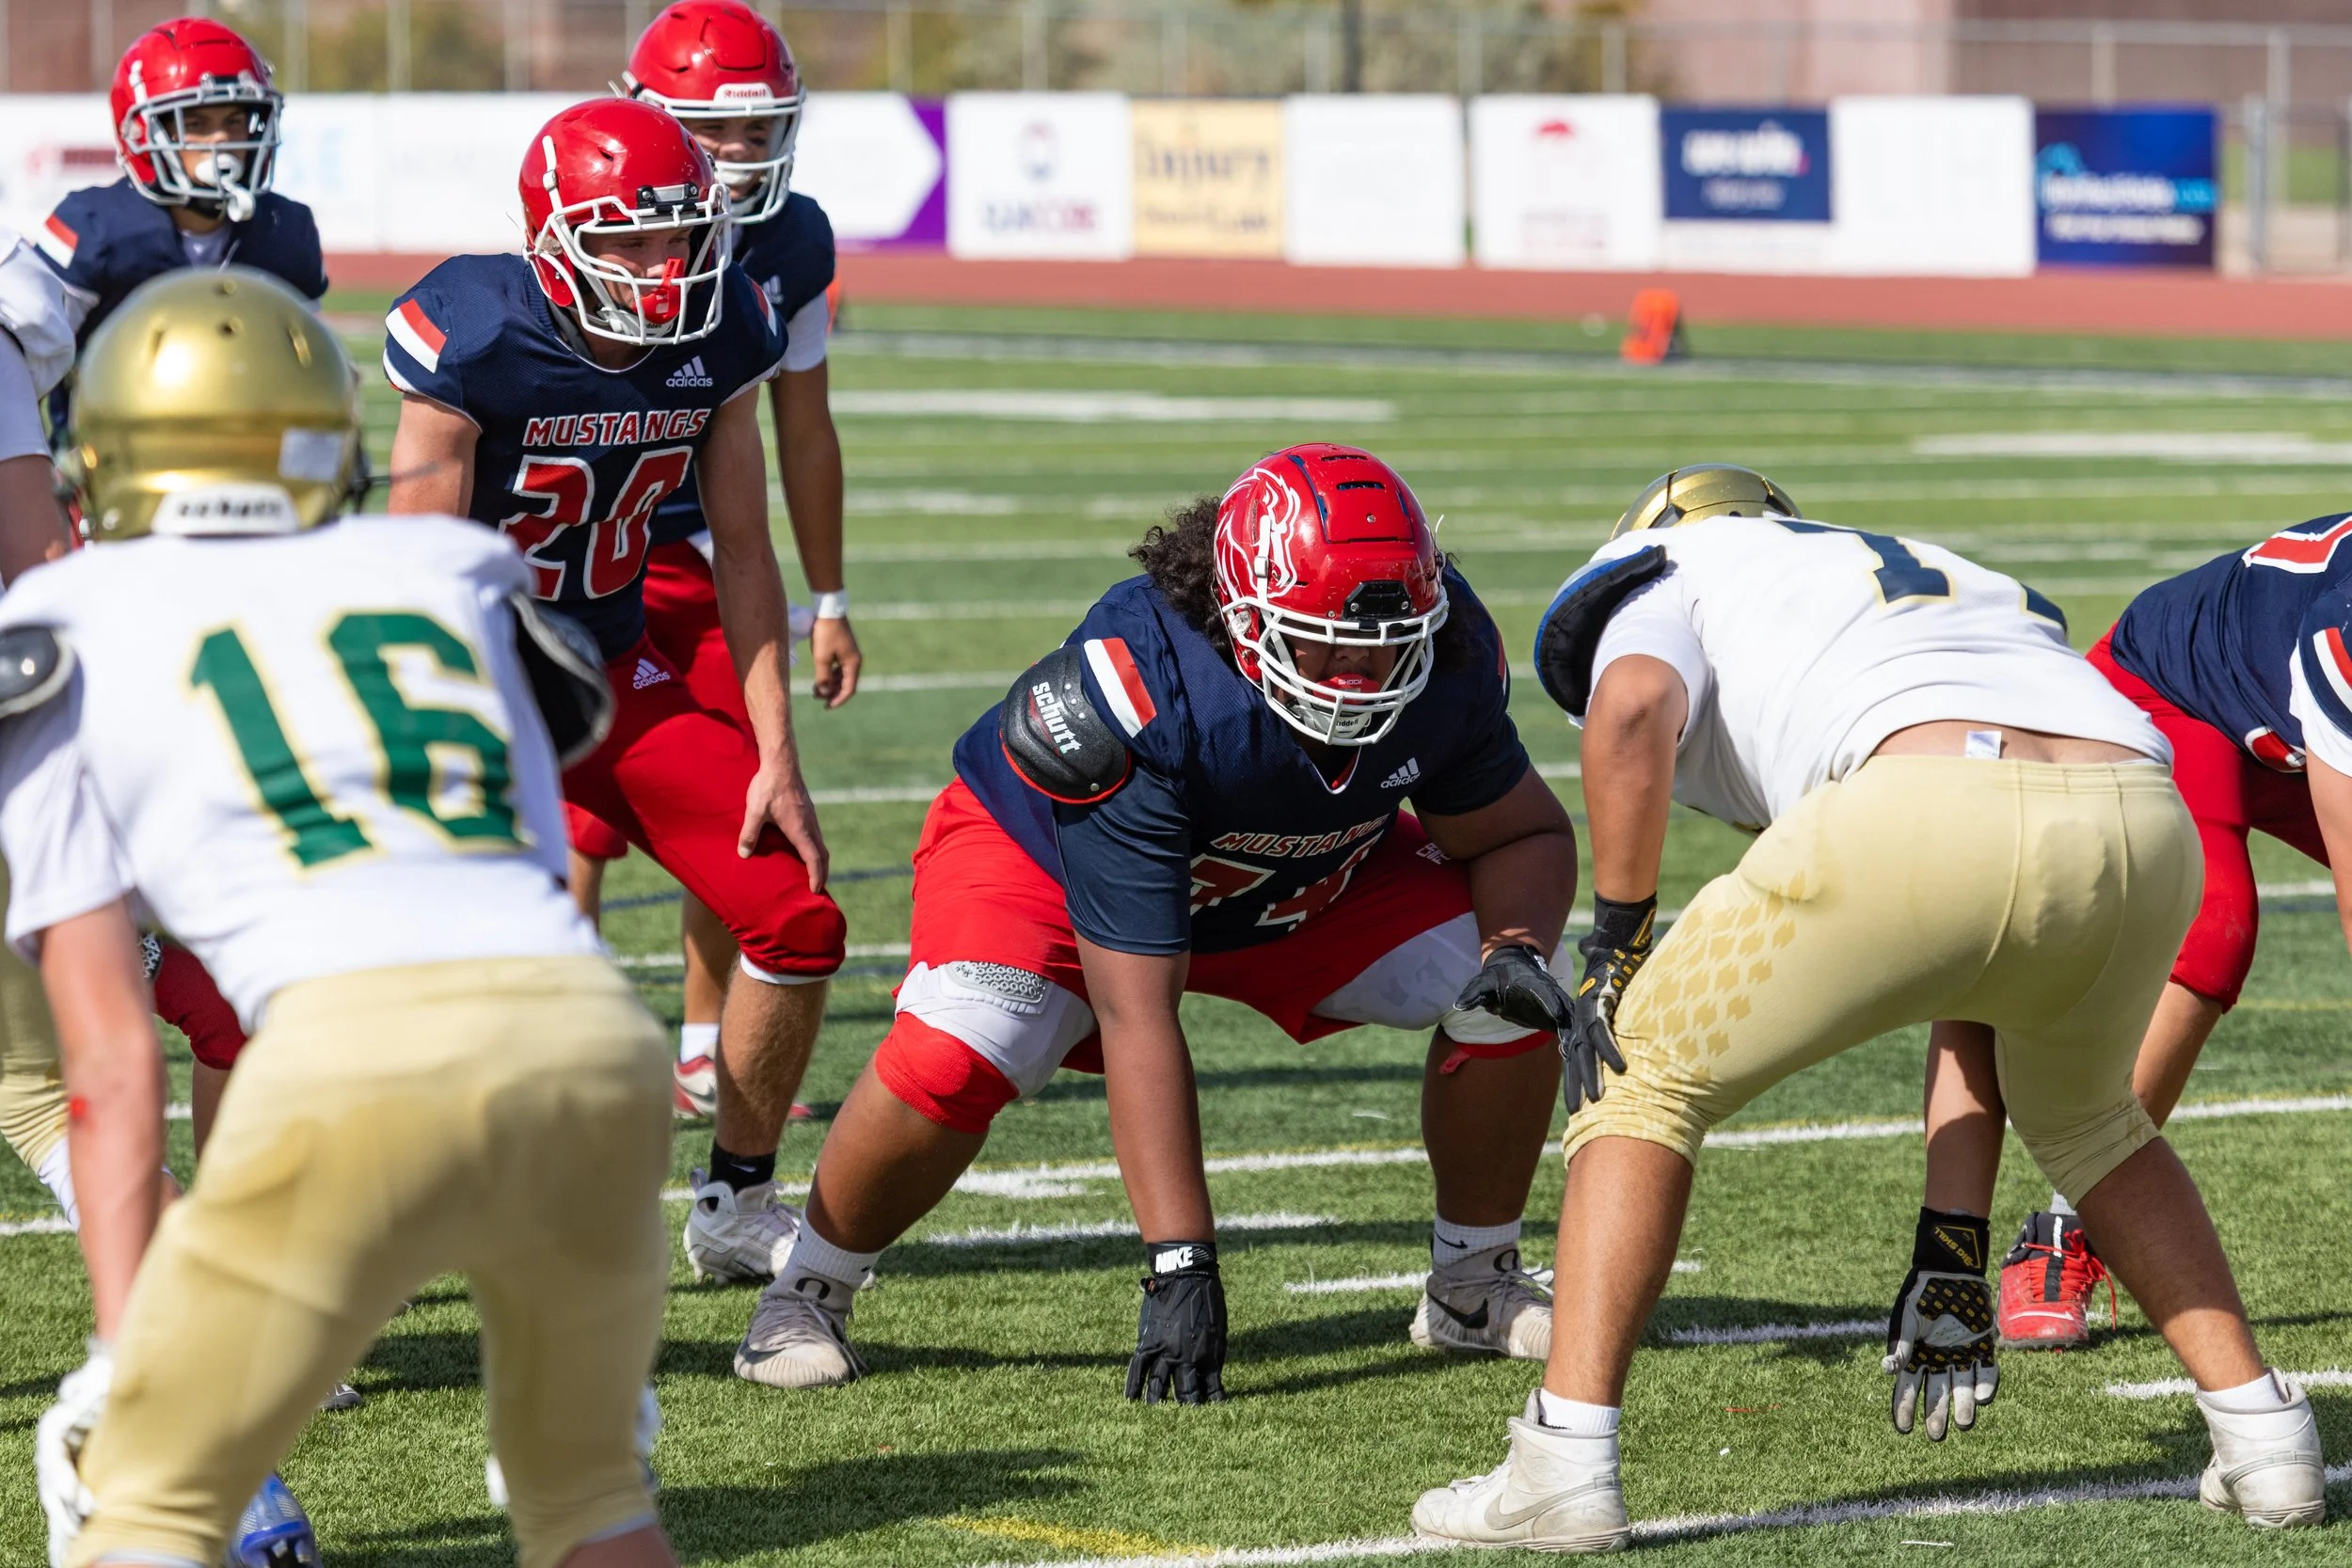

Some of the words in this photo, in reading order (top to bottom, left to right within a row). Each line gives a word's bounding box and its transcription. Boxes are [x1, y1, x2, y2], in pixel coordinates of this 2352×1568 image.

[665, 375, 713, 388] adidas
[522, 408, 712, 447] MUSTANGS
[497, 446, 693, 602] 20
[633, 672, 671, 689] adidas
[181, 606, 537, 882] 16
[1154, 1245, 1194, 1275] NIKE
